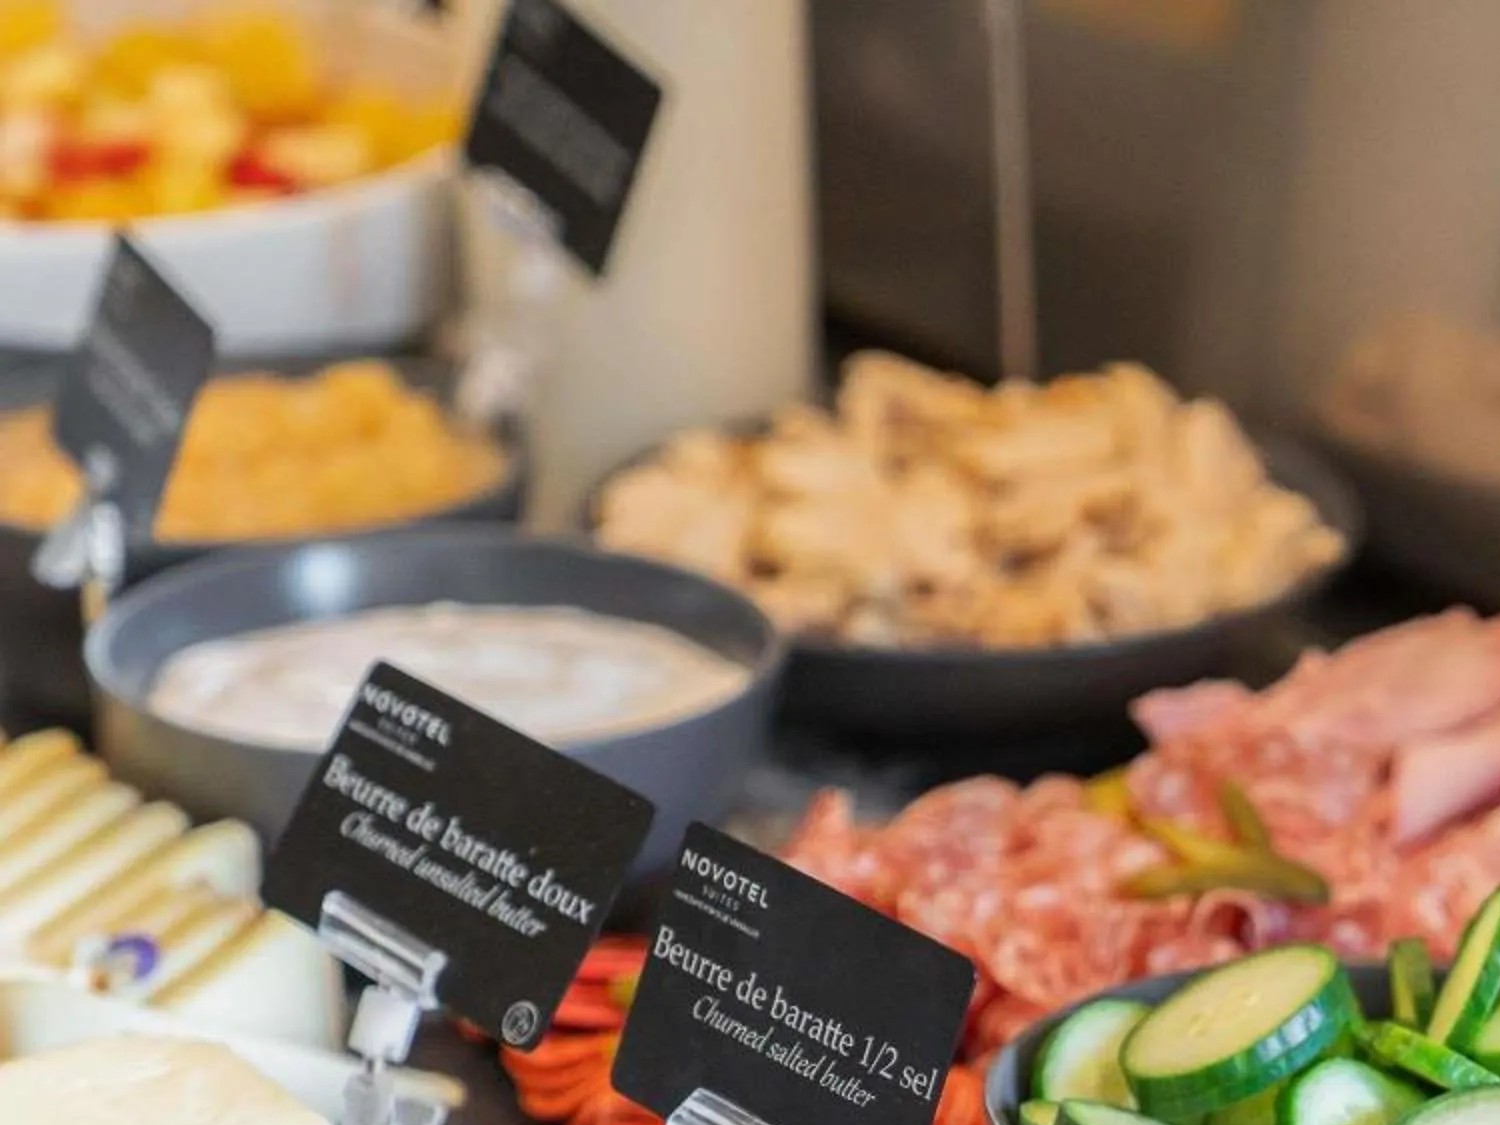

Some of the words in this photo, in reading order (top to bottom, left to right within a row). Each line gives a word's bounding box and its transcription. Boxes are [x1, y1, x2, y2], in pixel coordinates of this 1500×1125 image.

[364, 682, 452, 747] NOVOTEL
[323, 753, 408, 821] Beurre
[406, 804, 442, 839] de
[441, 817, 527, 887] baratte
[527, 869, 596, 925] doux
[340, 811, 425, 872] Churned
[415, 845, 497, 912] unsalted
[488, 885, 548, 938] butter
[681, 848, 768, 909] NOVOTEL
[653, 925, 732, 991] Beurre
[736, 973, 767, 1010] de
[771, 986, 854, 1057] baratte
[862, 1036, 898, 1080] 1/2
[900, 1068, 939, 1100] sel
[693, 995, 770, 1052] Churned
[766, 1040, 825, 1082] salted
[820, 1060, 876, 1108] butter
